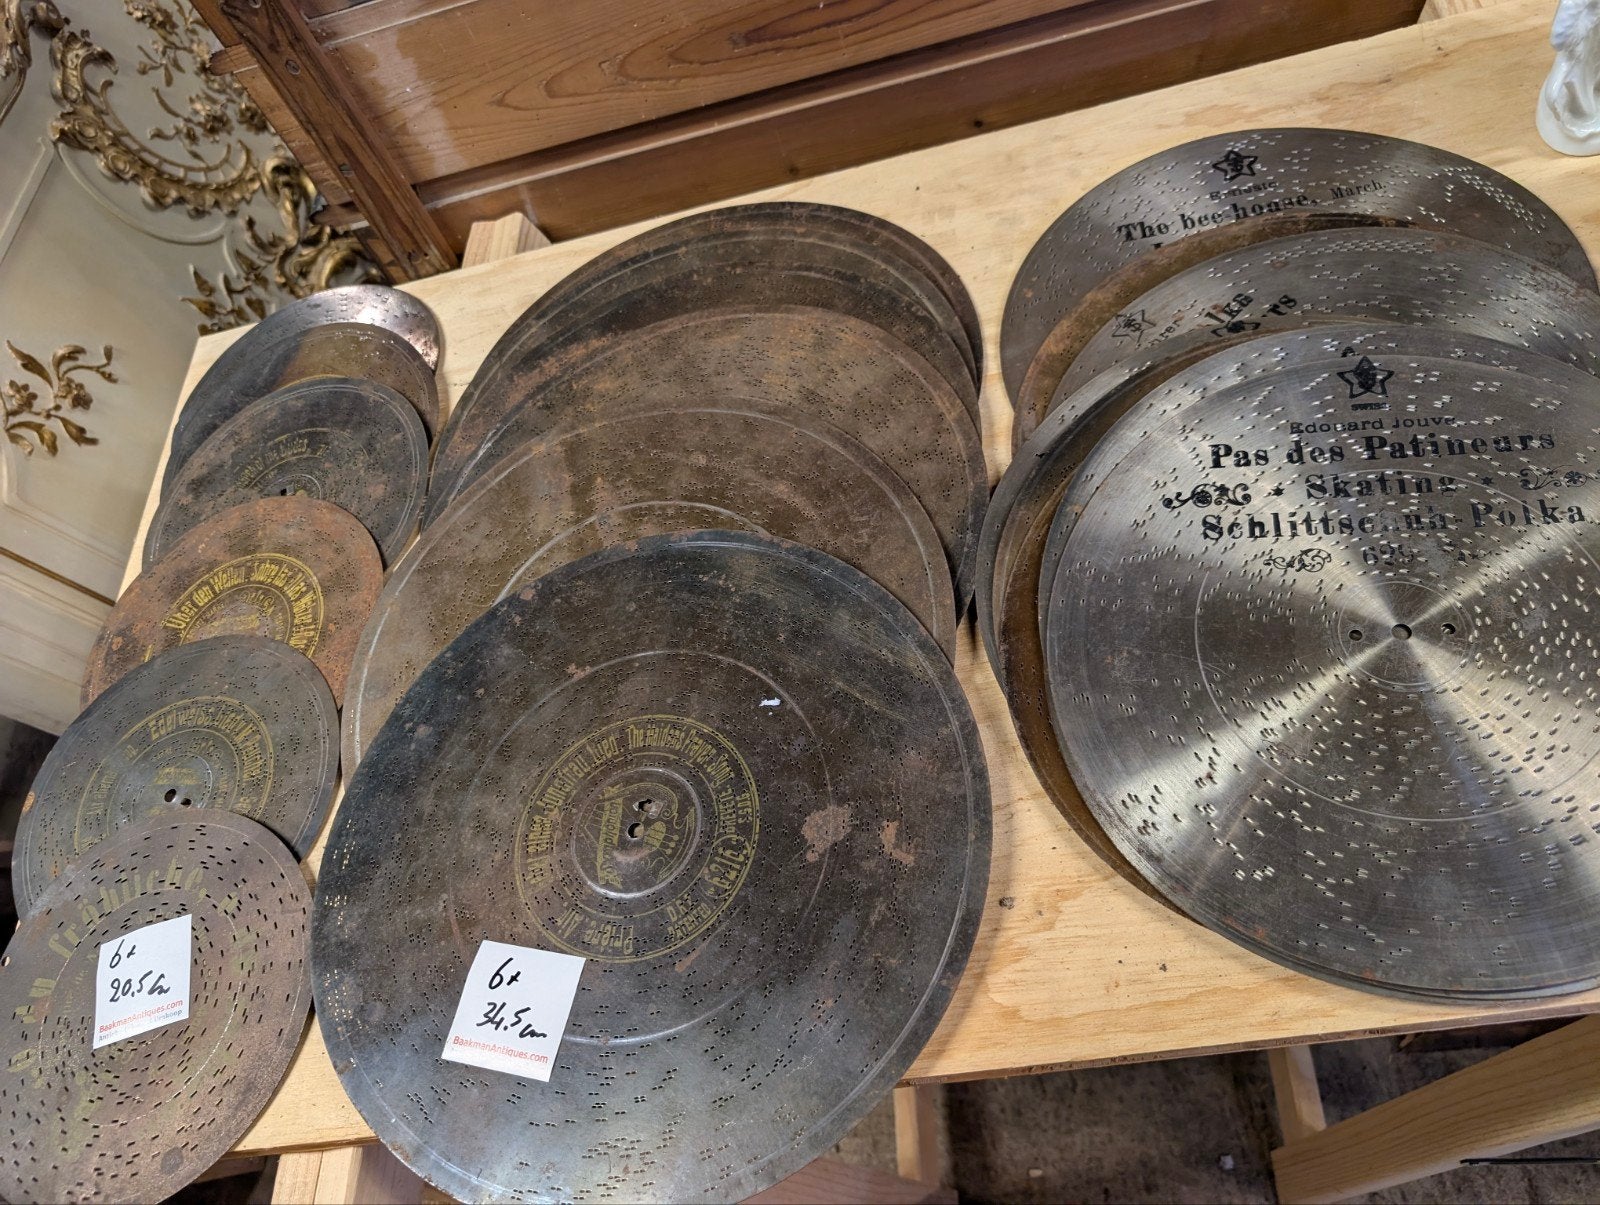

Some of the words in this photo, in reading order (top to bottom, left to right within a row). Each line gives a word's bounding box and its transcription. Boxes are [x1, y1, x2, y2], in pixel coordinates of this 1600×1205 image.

[1116, 222, 1169, 242] The
[1330, 179, 1386, 200] March.
[1290, 418, 1383, 434] Edouard
[1208, 444, 1269, 468] Pas
[1286, 440, 1344, 465] des
[1364, 433, 1554, 460] Patineurs
[1305, 471, 1458, 499] Skating
[626, 724, 645, 749] The
[99, 999, 183, 1033] BaakmanAntiques.com
[453, 1035, 549, 1065] BaakmanAntiques.com
